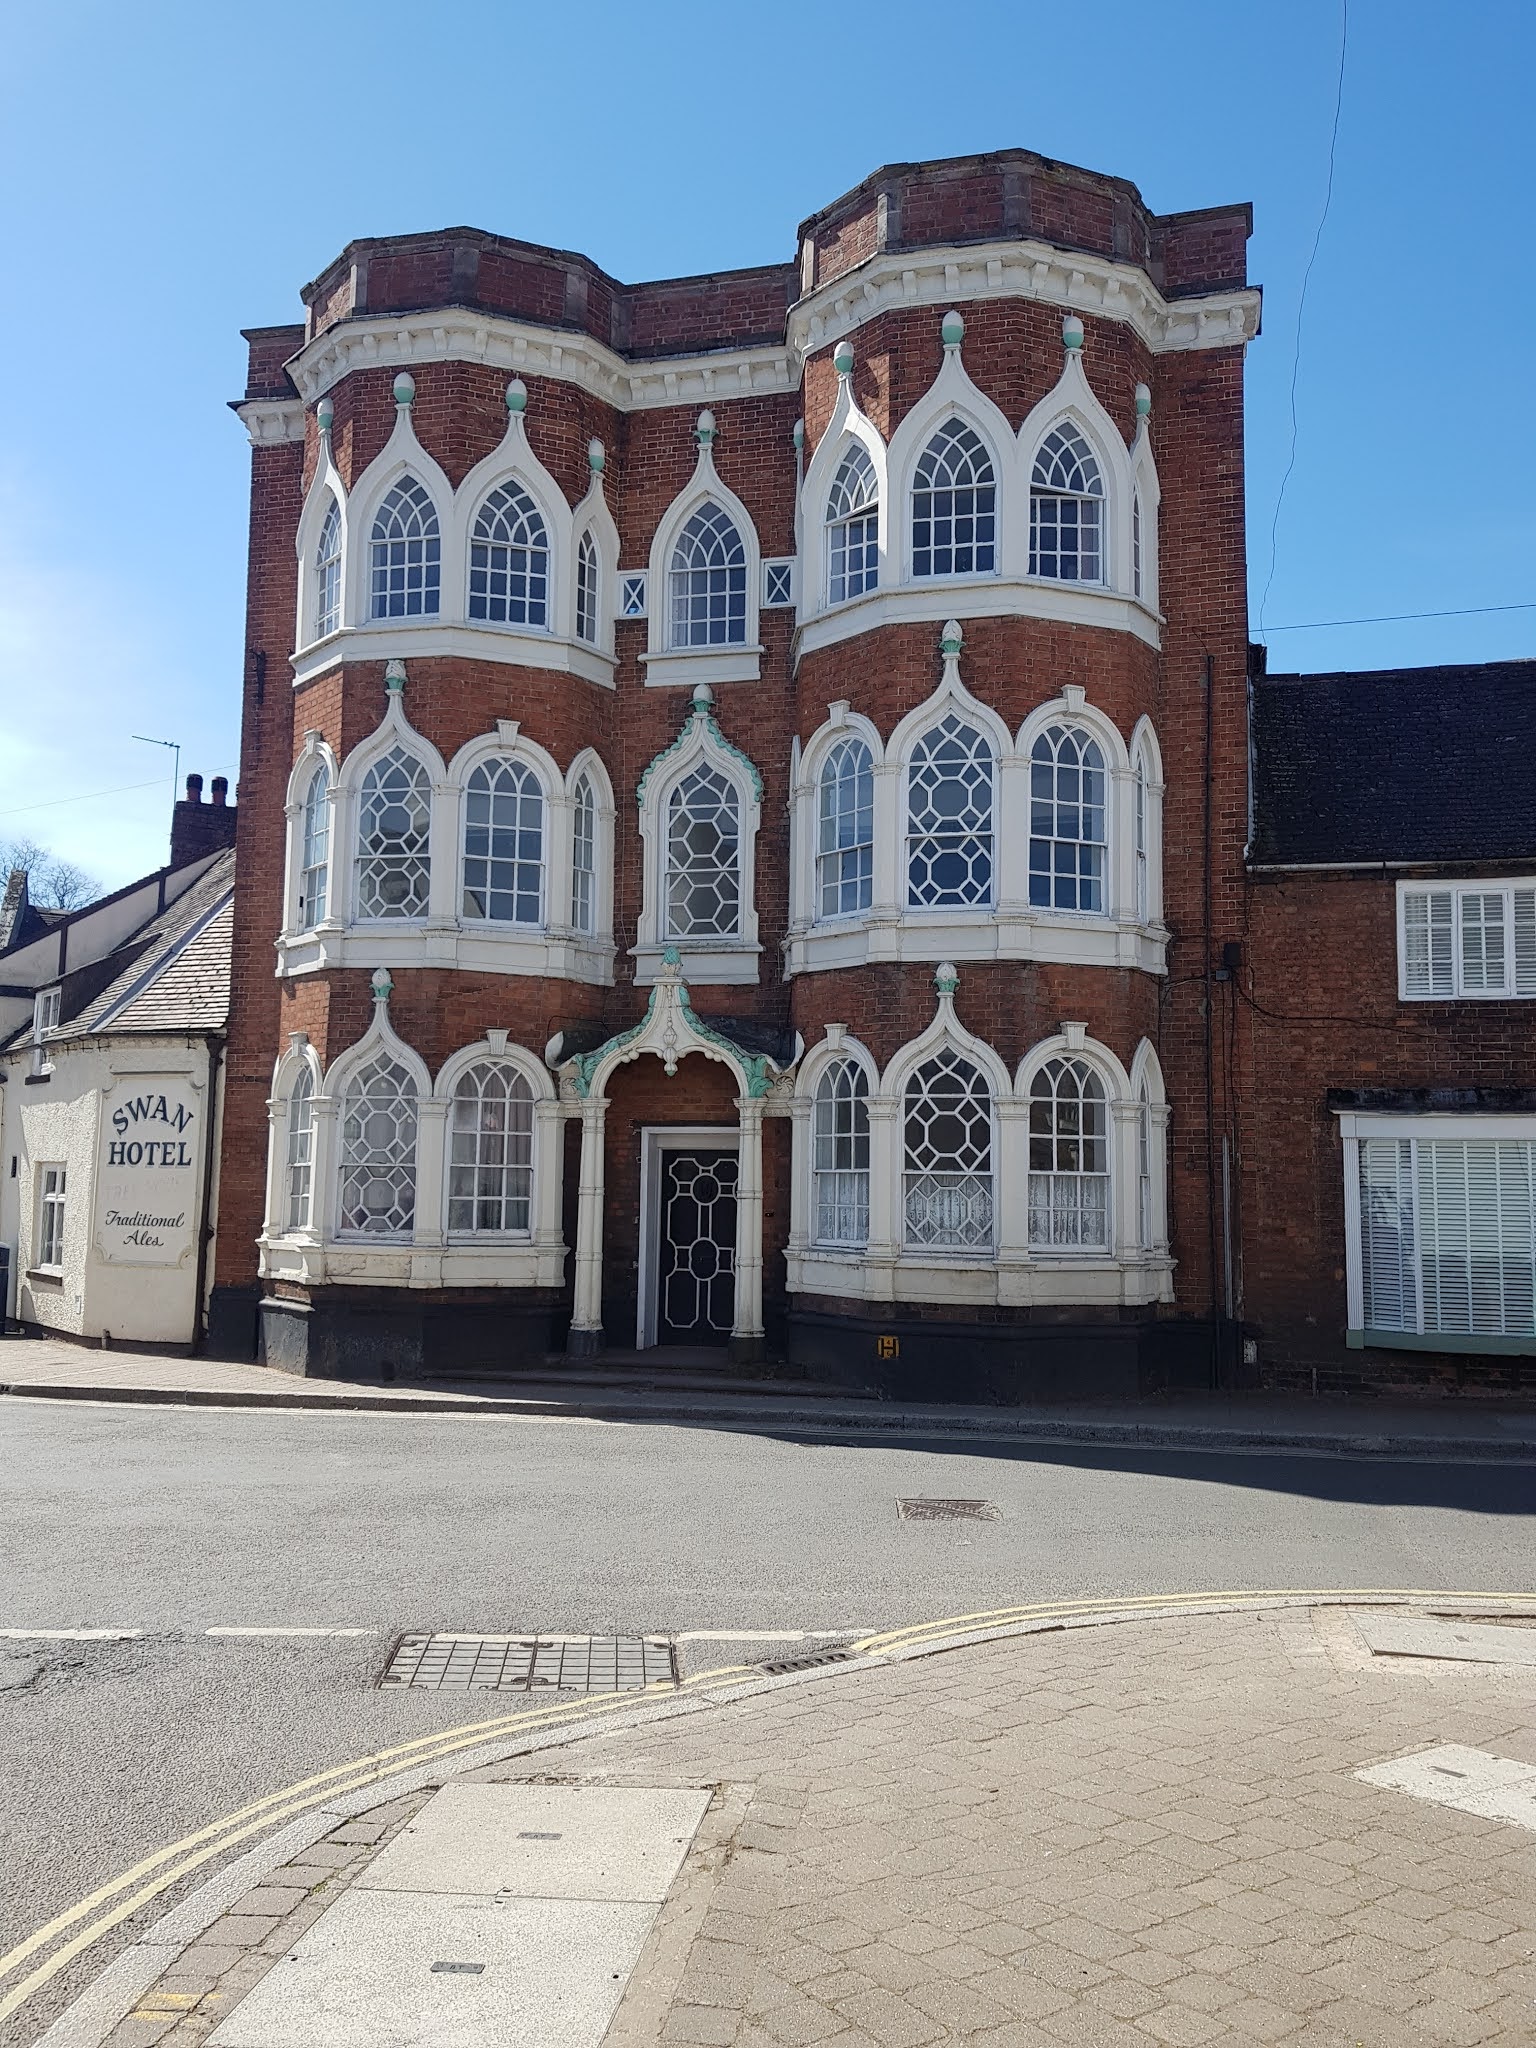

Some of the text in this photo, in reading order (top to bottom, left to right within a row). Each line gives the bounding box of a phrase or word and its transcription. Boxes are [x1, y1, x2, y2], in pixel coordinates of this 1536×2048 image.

[112, 1095, 194, 1135] SWAN
[108, 1142, 192, 1166] HOTEL
[105, 1210, 185, 1228] Traditional
[123, 1230, 164, 1247] Ales
